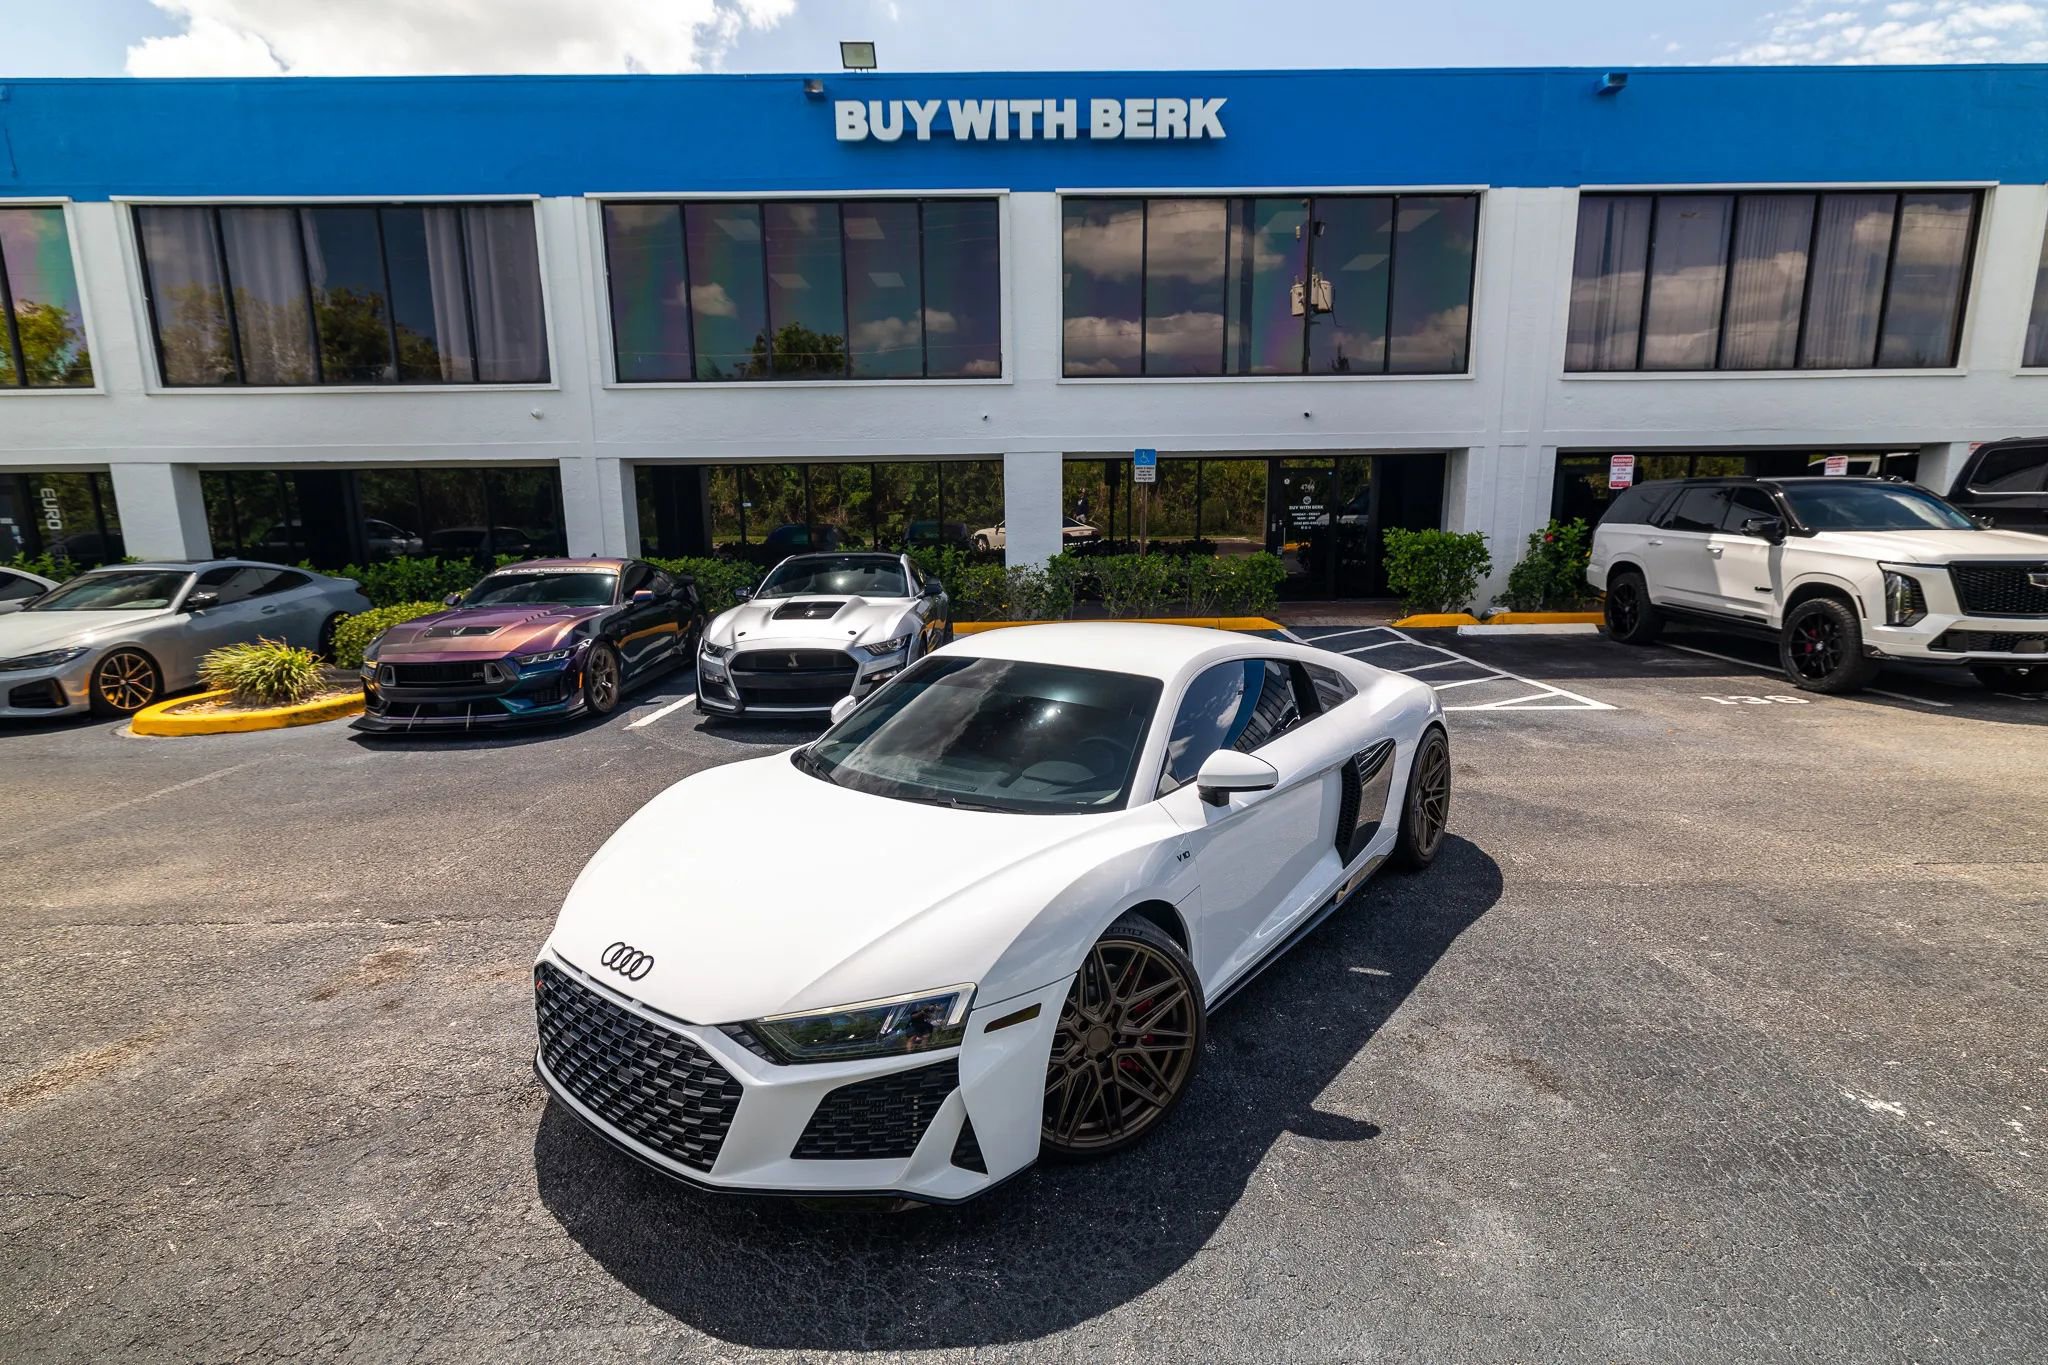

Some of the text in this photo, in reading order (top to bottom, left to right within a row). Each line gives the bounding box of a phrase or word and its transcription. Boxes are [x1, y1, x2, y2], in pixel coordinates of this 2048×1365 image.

[835, 98, 1228, 141] BUY WITH BERK
[40, 487, 63, 530] EURO
[1700, 695, 1810, 705] 138
[1176, 850, 1190, 862] V10
